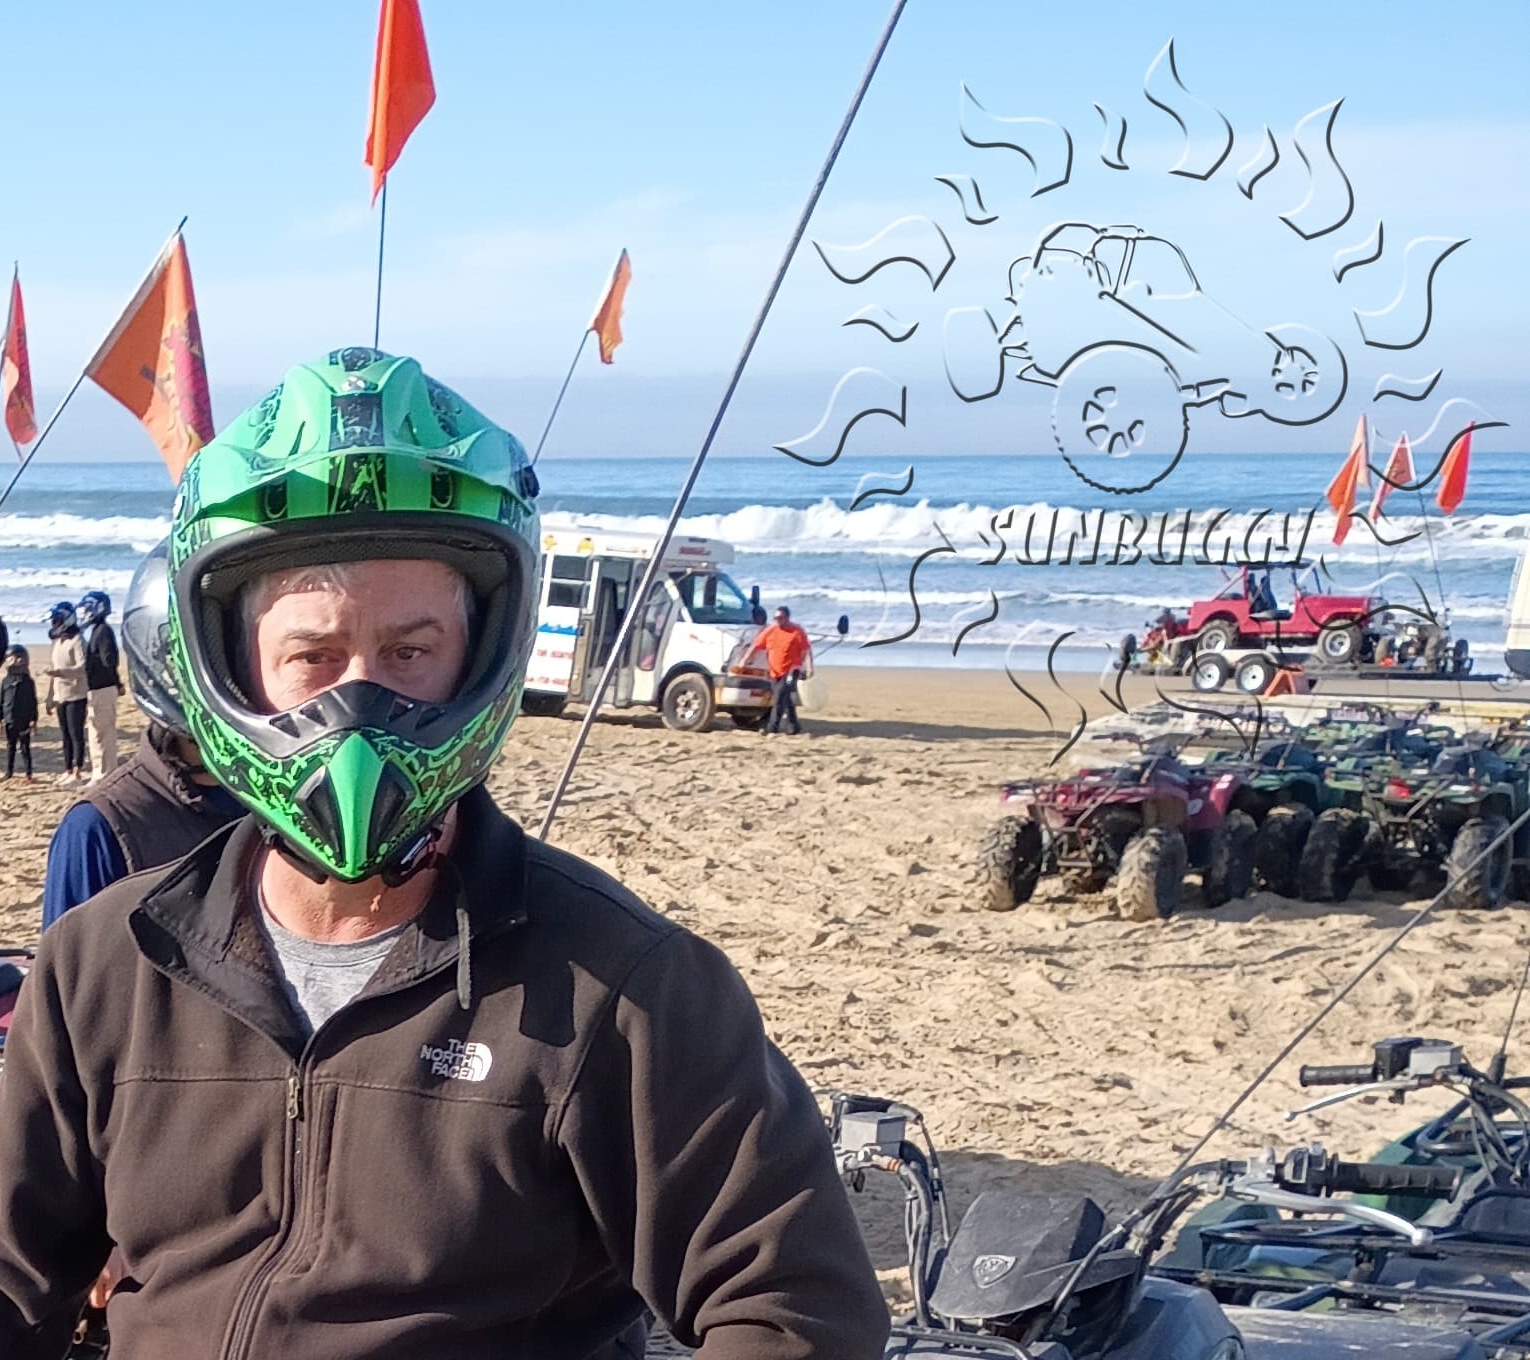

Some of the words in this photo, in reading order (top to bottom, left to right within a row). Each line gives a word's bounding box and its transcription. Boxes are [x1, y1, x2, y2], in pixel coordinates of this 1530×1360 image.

[419, 1044, 473, 1068] NORTH
[448, 1038, 478, 1055] THE
[431, 1061, 471, 1080] FACE
